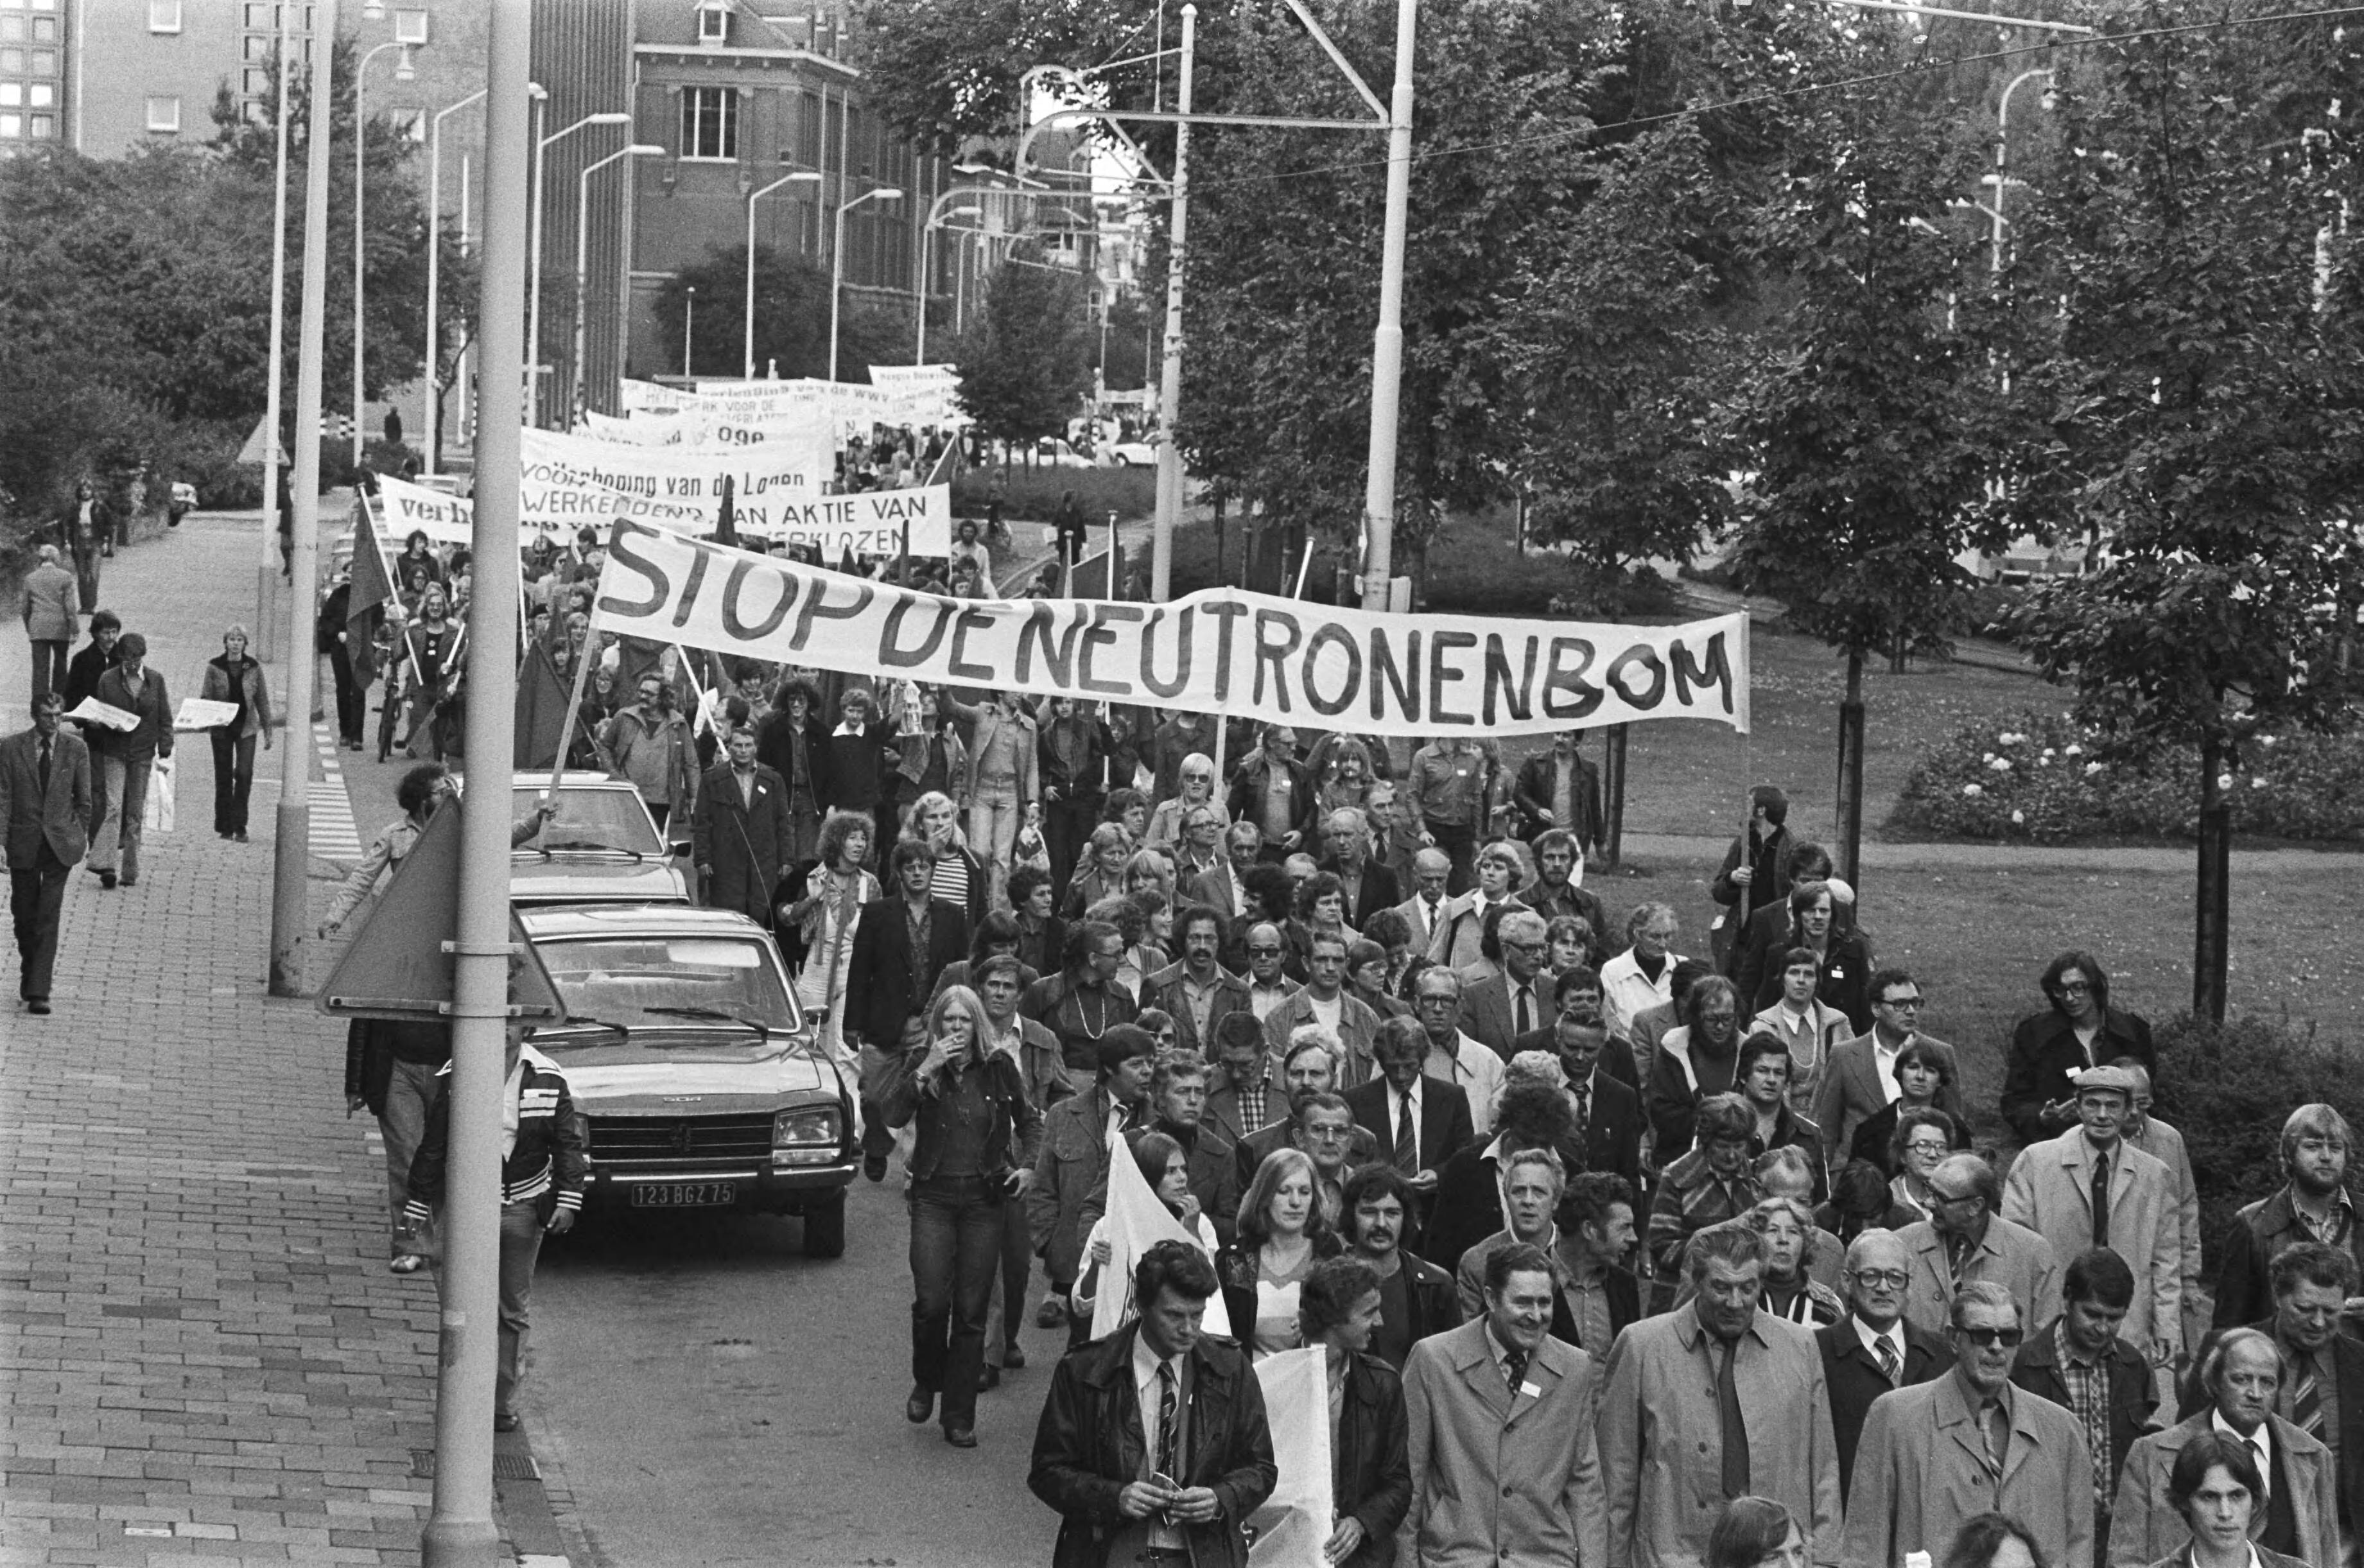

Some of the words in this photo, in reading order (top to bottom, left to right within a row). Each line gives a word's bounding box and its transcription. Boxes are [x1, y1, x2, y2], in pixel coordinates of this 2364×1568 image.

[723, 400, 755, 413] VOOR
[760, 399, 776, 412] DE
[666, 476, 701, 496] van
[782, 501, 856, 525] AKTIE
[871, 495, 926, 520] VAN
[597, 518, 874, 652] STOP
[878, 591, 1016, 681] DE
[1014, 600, 1735, 726] NEUTRONENBOM
[637, 1186, 668, 1205] 123
[673, 1185, 706, 1204] BGZ
[710, 1183, 732, 1203] 75
